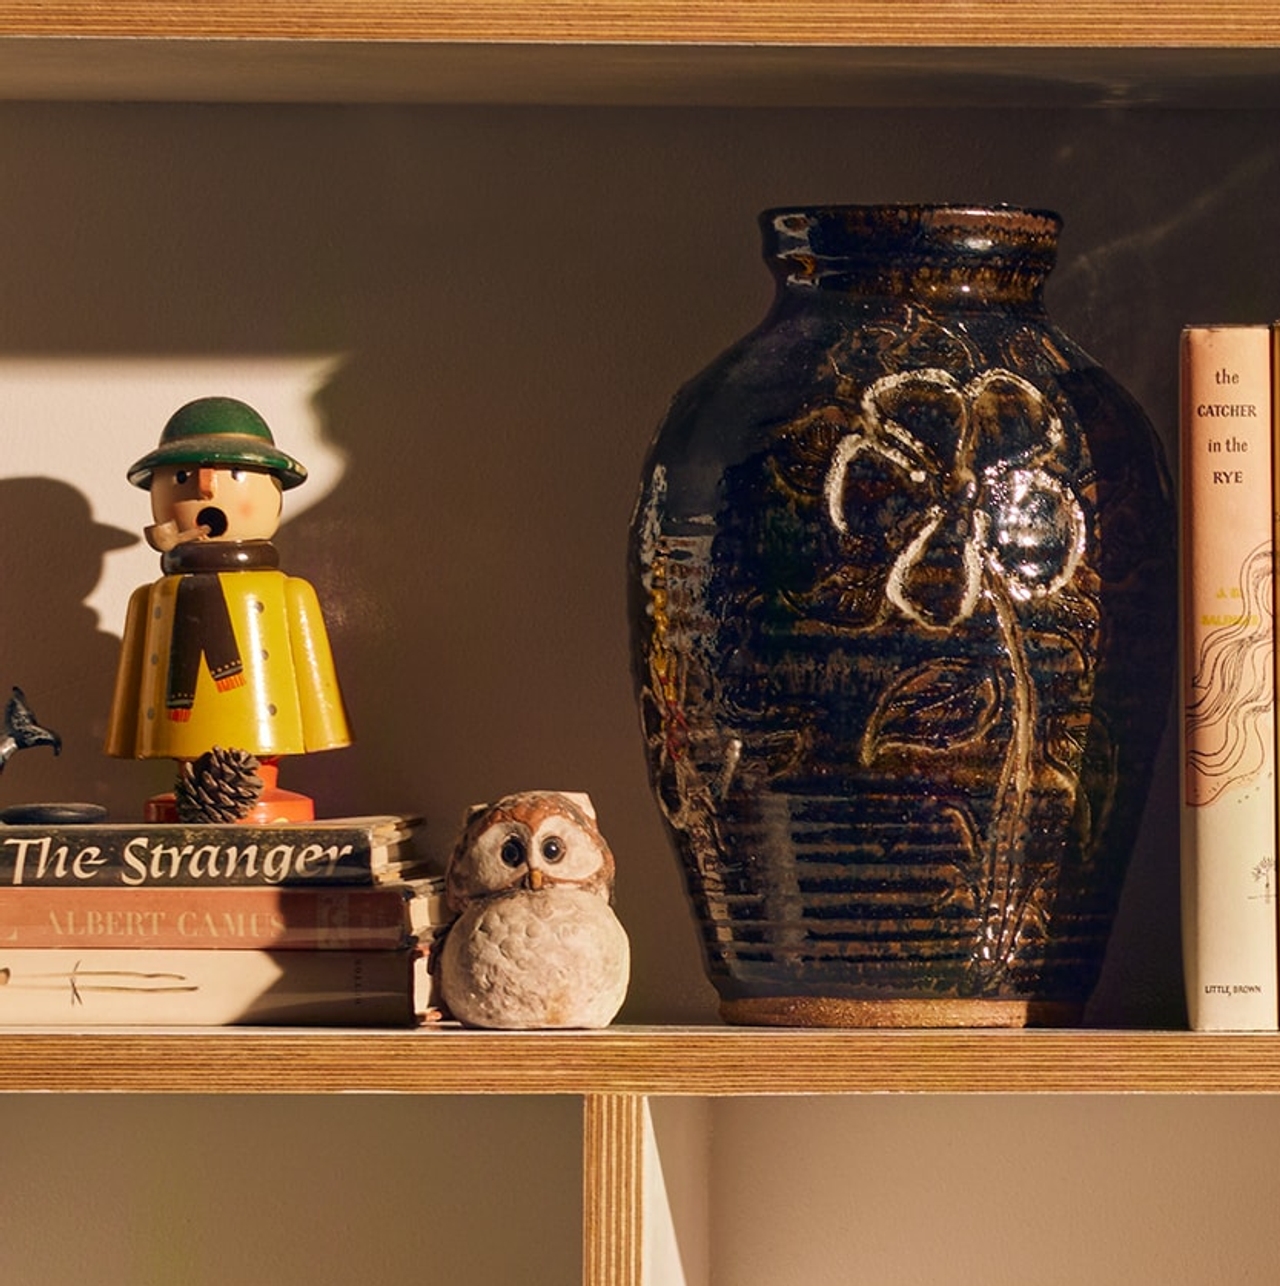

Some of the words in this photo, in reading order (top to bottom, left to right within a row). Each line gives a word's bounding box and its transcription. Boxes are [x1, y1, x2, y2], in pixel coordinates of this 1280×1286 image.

[1215, 369, 1240, 385] the
[1197, 404, 1258, 418] CATCHER
[1207, 439, 1223, 453] in
[1226, 439, 1249, 453] the
[1213, 472, 1244, 484] RYE
[3, 837, 107, 885] The
[121, 837, 353, 885] Stranger
[48, 910, 165, 937] ALBERT
[177, 910, 287, 938] CAMUS
[1233, 985, 1262, 994] BROWN
